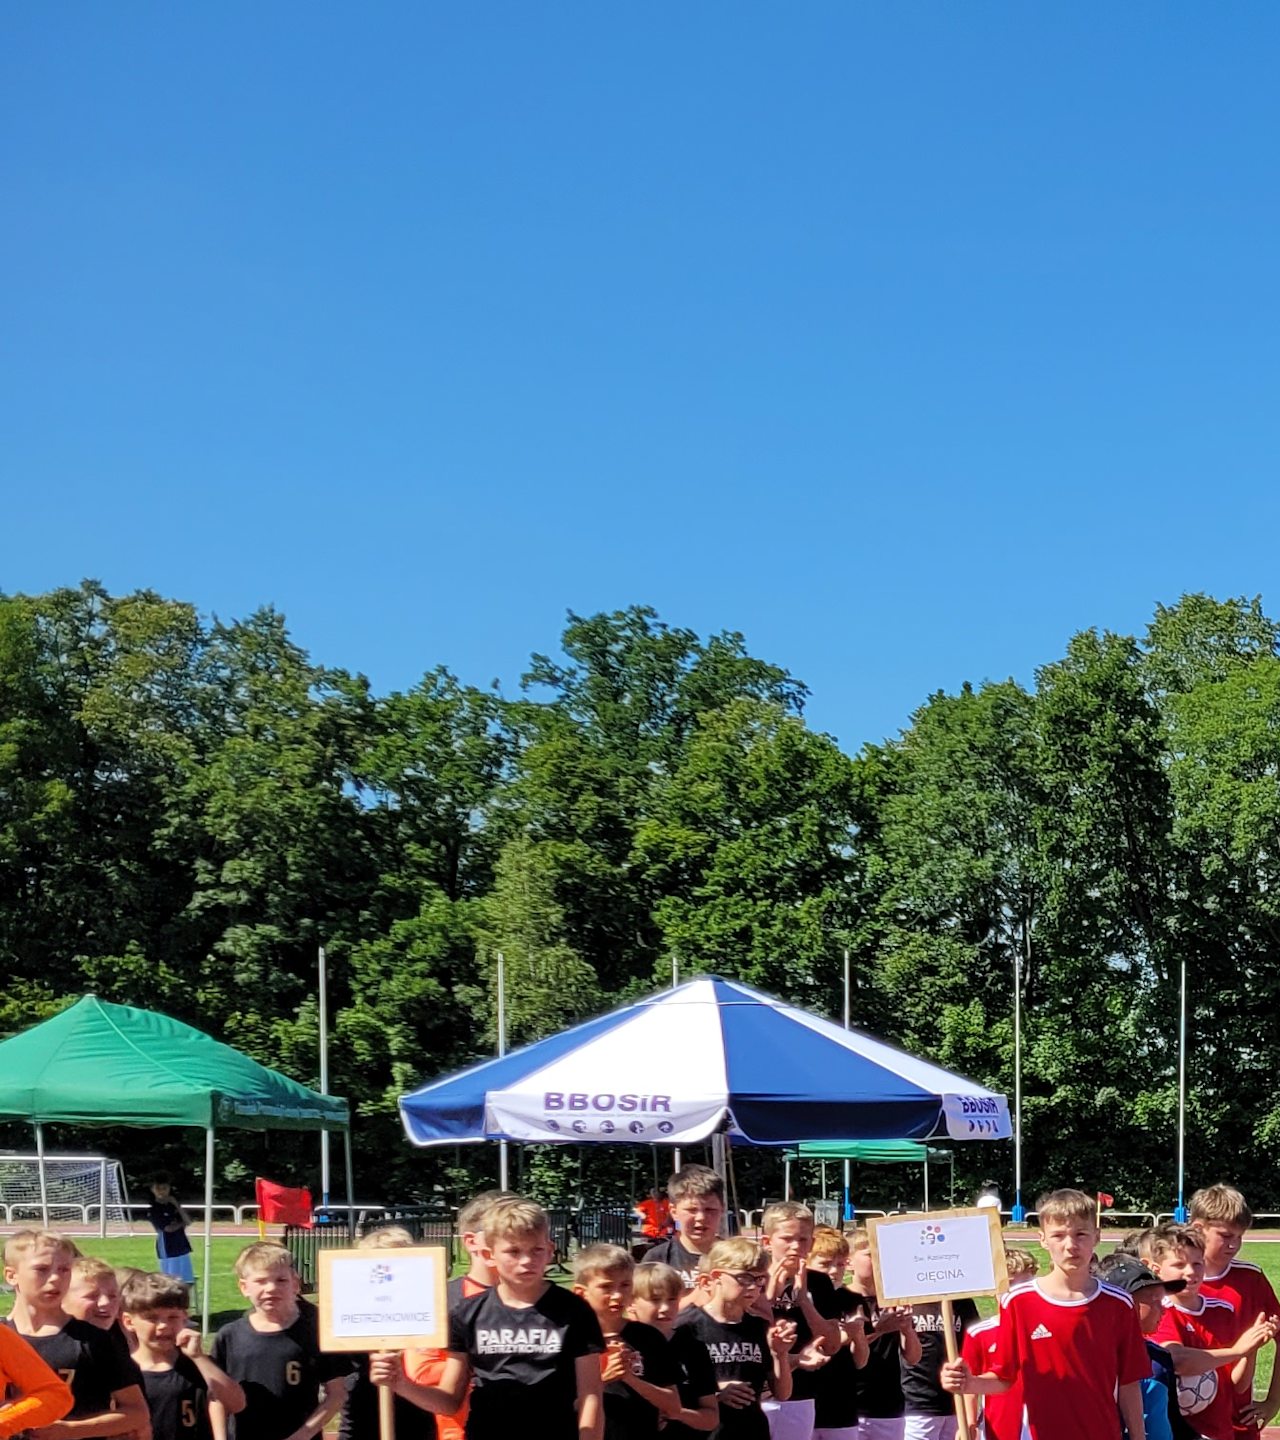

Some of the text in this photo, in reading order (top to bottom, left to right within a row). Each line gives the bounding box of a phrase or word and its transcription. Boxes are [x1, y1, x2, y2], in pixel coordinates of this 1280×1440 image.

[916, 1268, 965, 1282] CIĘCINA
[477, 1328, 562, 1345] PARAFIA
[286, 1361, 301, 1386] 6
[182, 1399, 196, 1427] 5
